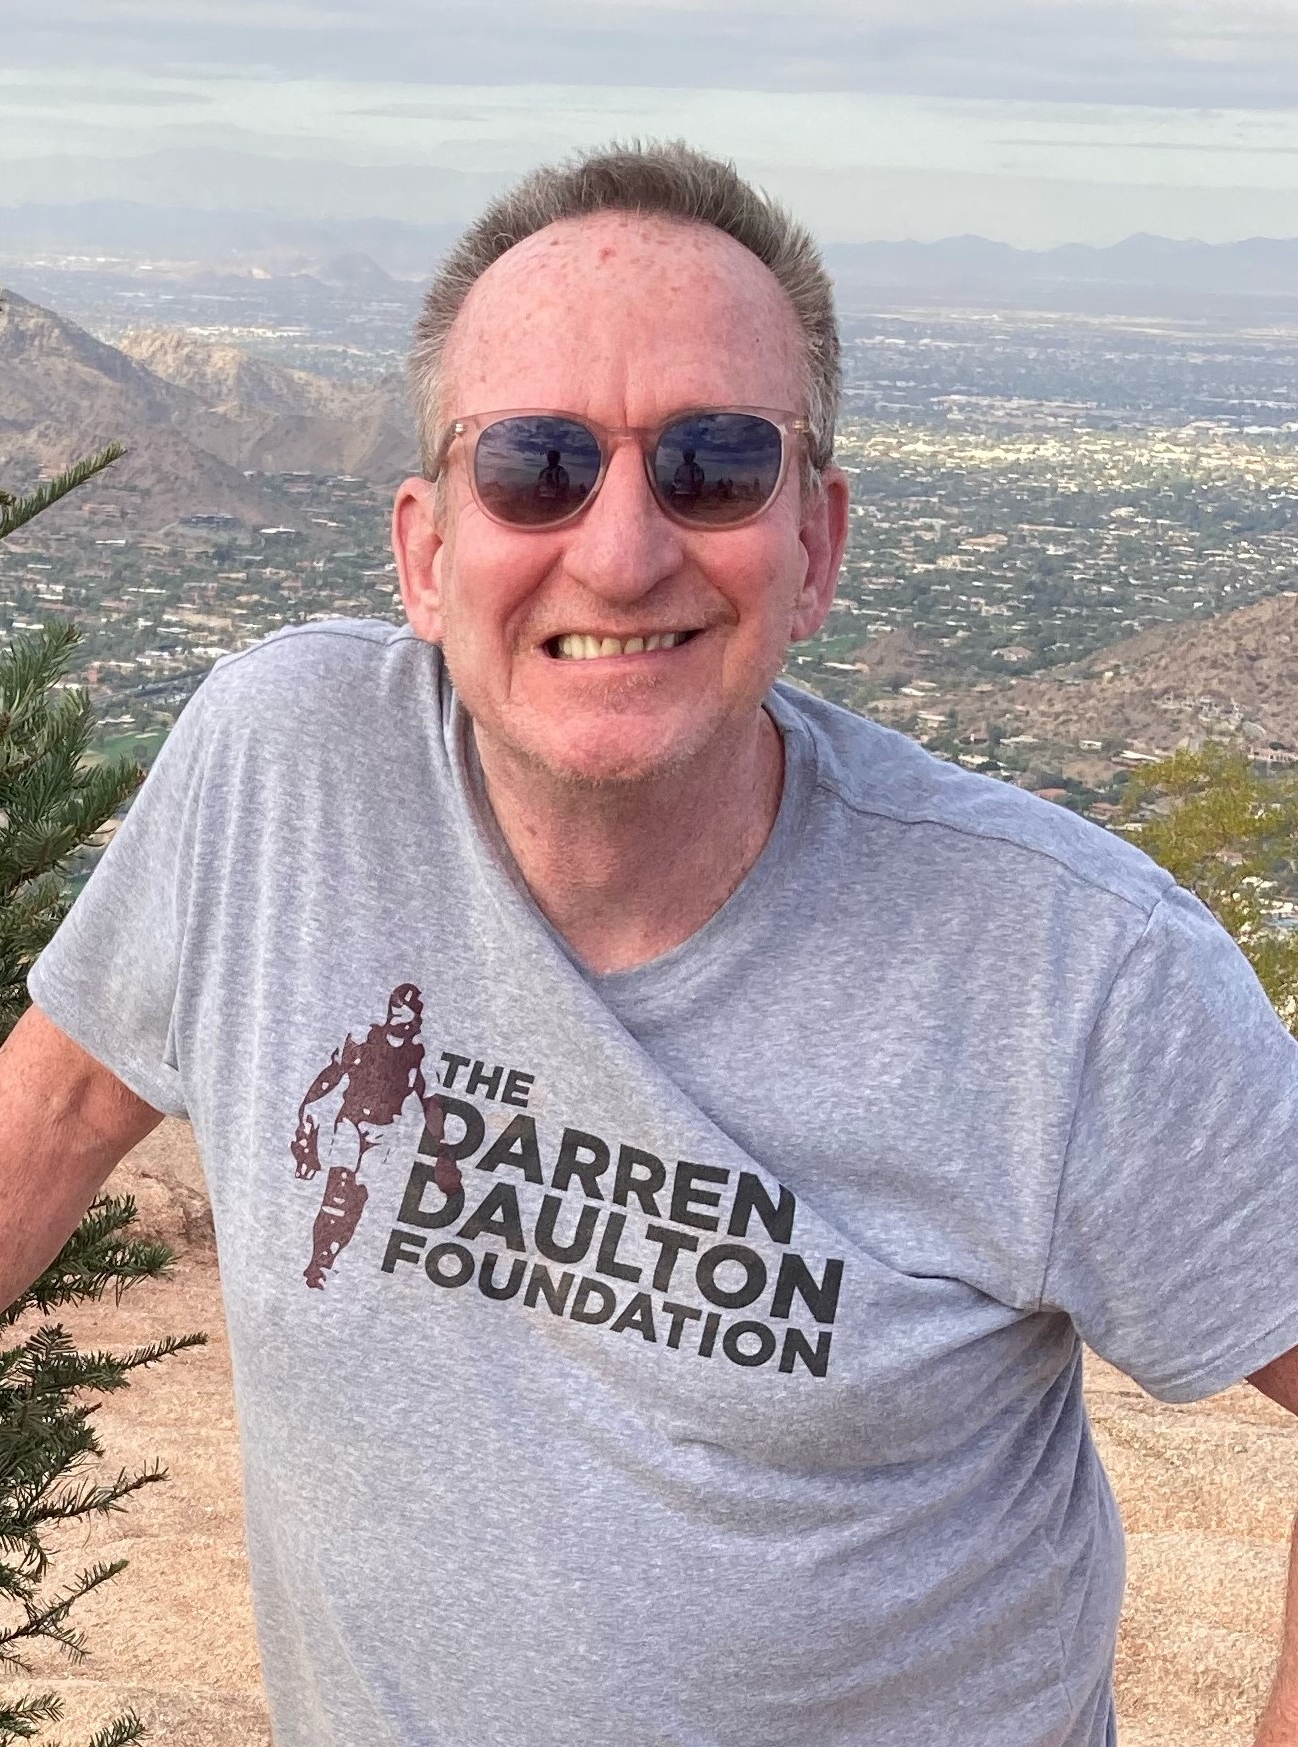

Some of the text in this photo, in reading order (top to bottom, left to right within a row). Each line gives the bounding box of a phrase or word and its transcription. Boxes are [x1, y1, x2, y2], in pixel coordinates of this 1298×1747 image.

[440, 1051, 536, 1108] THE
[396, 1161, 845, 1325] DAULTON
[417, 1093, 797, 1245] DARREN
[380, 1229, 833, 1378] FOUNDATION
